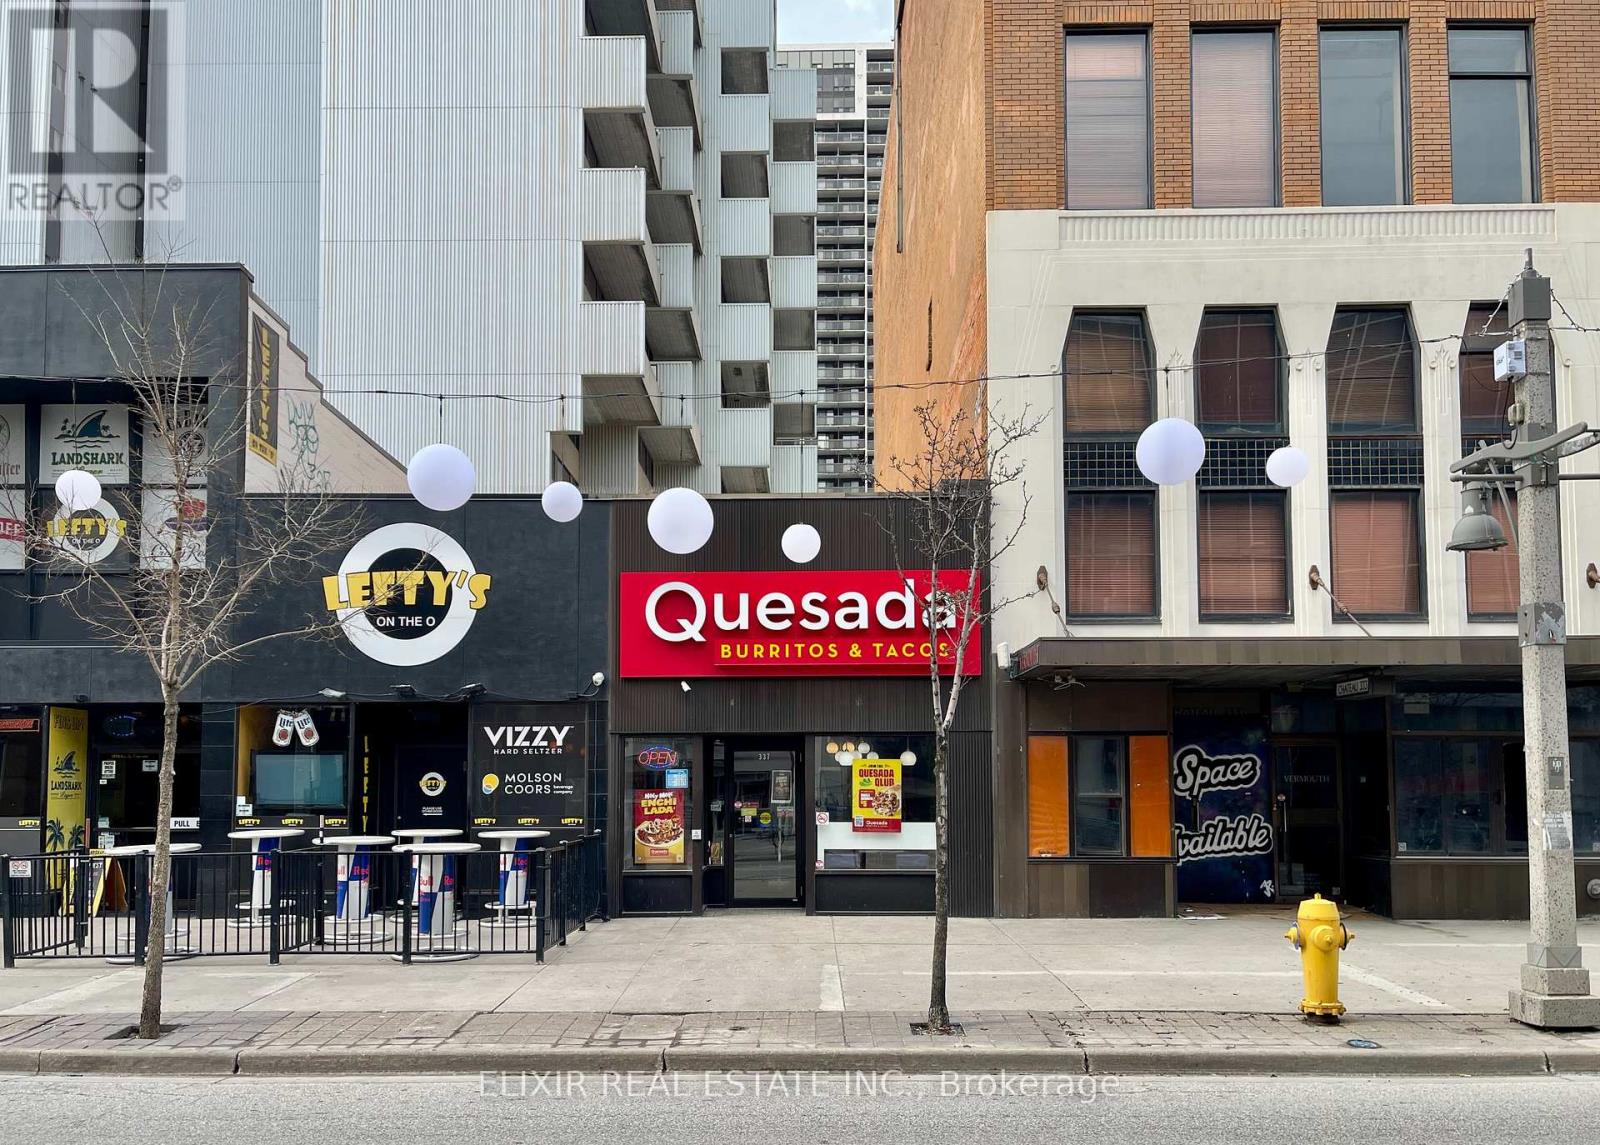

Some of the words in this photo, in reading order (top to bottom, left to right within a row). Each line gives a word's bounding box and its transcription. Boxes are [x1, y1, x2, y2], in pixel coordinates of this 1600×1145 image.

[51, 451, 124, 466] LANDSHARK
[322, 569, 492, 611] LEFTY'S
[645, 578, 957, 642] Quesada
[376, 616, 395, 627] ON
[398, 616, 423, 627] THE
[425, 616, 436, 627] O
[720, 643, 838, 659] BURRITOS
[849, 643, 862, 658] &
[872, 642, 949, 658] TACOS
[483, 726, 571, 747] VIZZY
[639, 751, 676, 765] OPEN
[759, 753, 770, 761] 337
[505, 772, 562, 783] MOLSON
[859, 769, 894, 778] QUESADA
[1177, 754, 1253, 796] Space
[51, 780, 82, 791] LANDSHARK
[505, 784, 551, 795] COORS
[174, 820, 190, 828] PULL
[1176, 818, 1269, 856] vailable
